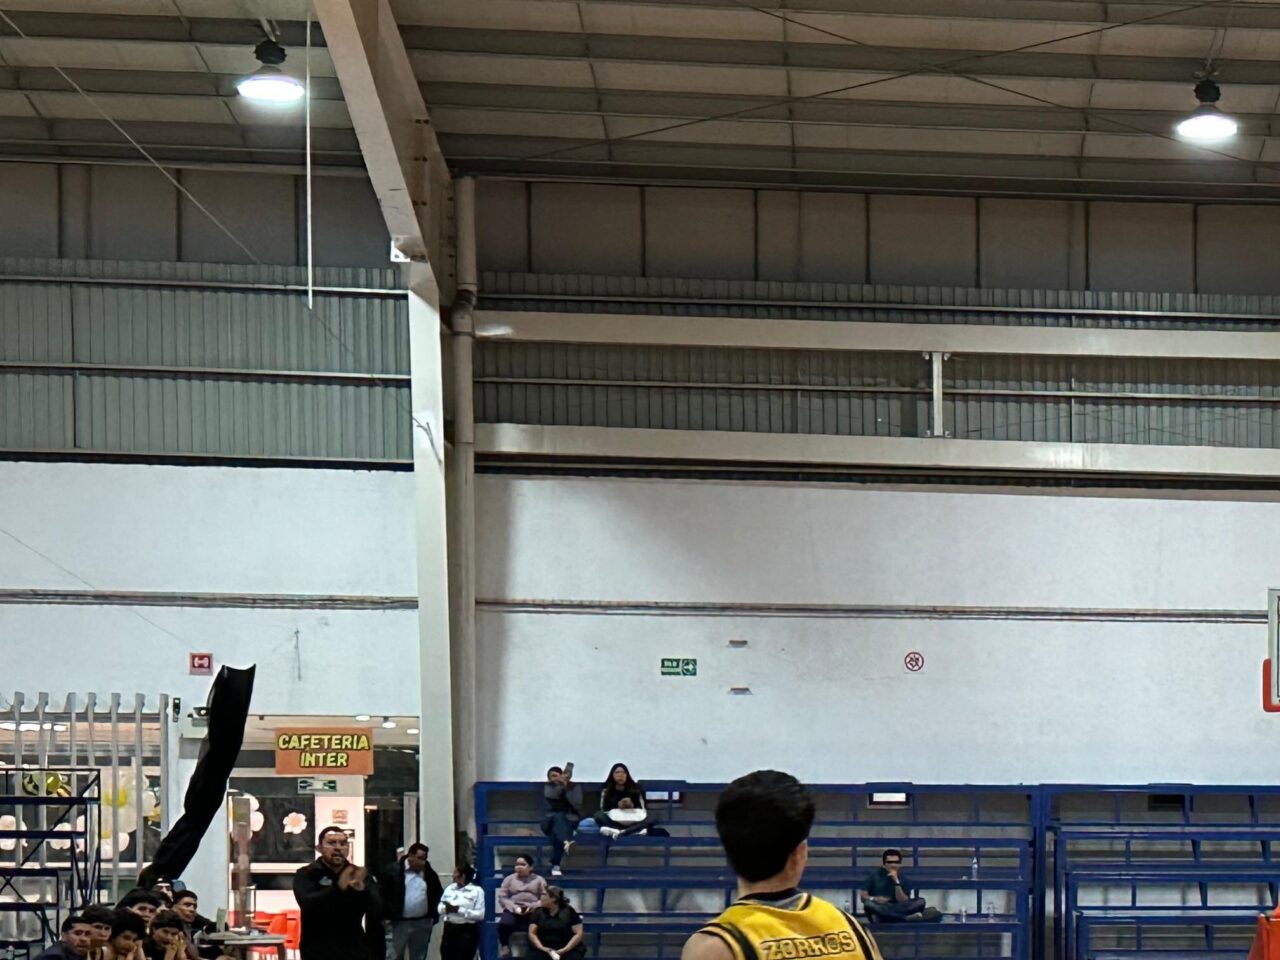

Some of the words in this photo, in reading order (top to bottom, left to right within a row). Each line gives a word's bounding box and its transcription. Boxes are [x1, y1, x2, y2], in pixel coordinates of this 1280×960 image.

[278, 735, 369, 750] CAFETERIA
[300, 751, 347, 767] INTER
[761, 931, 855, 960] ZORROS
